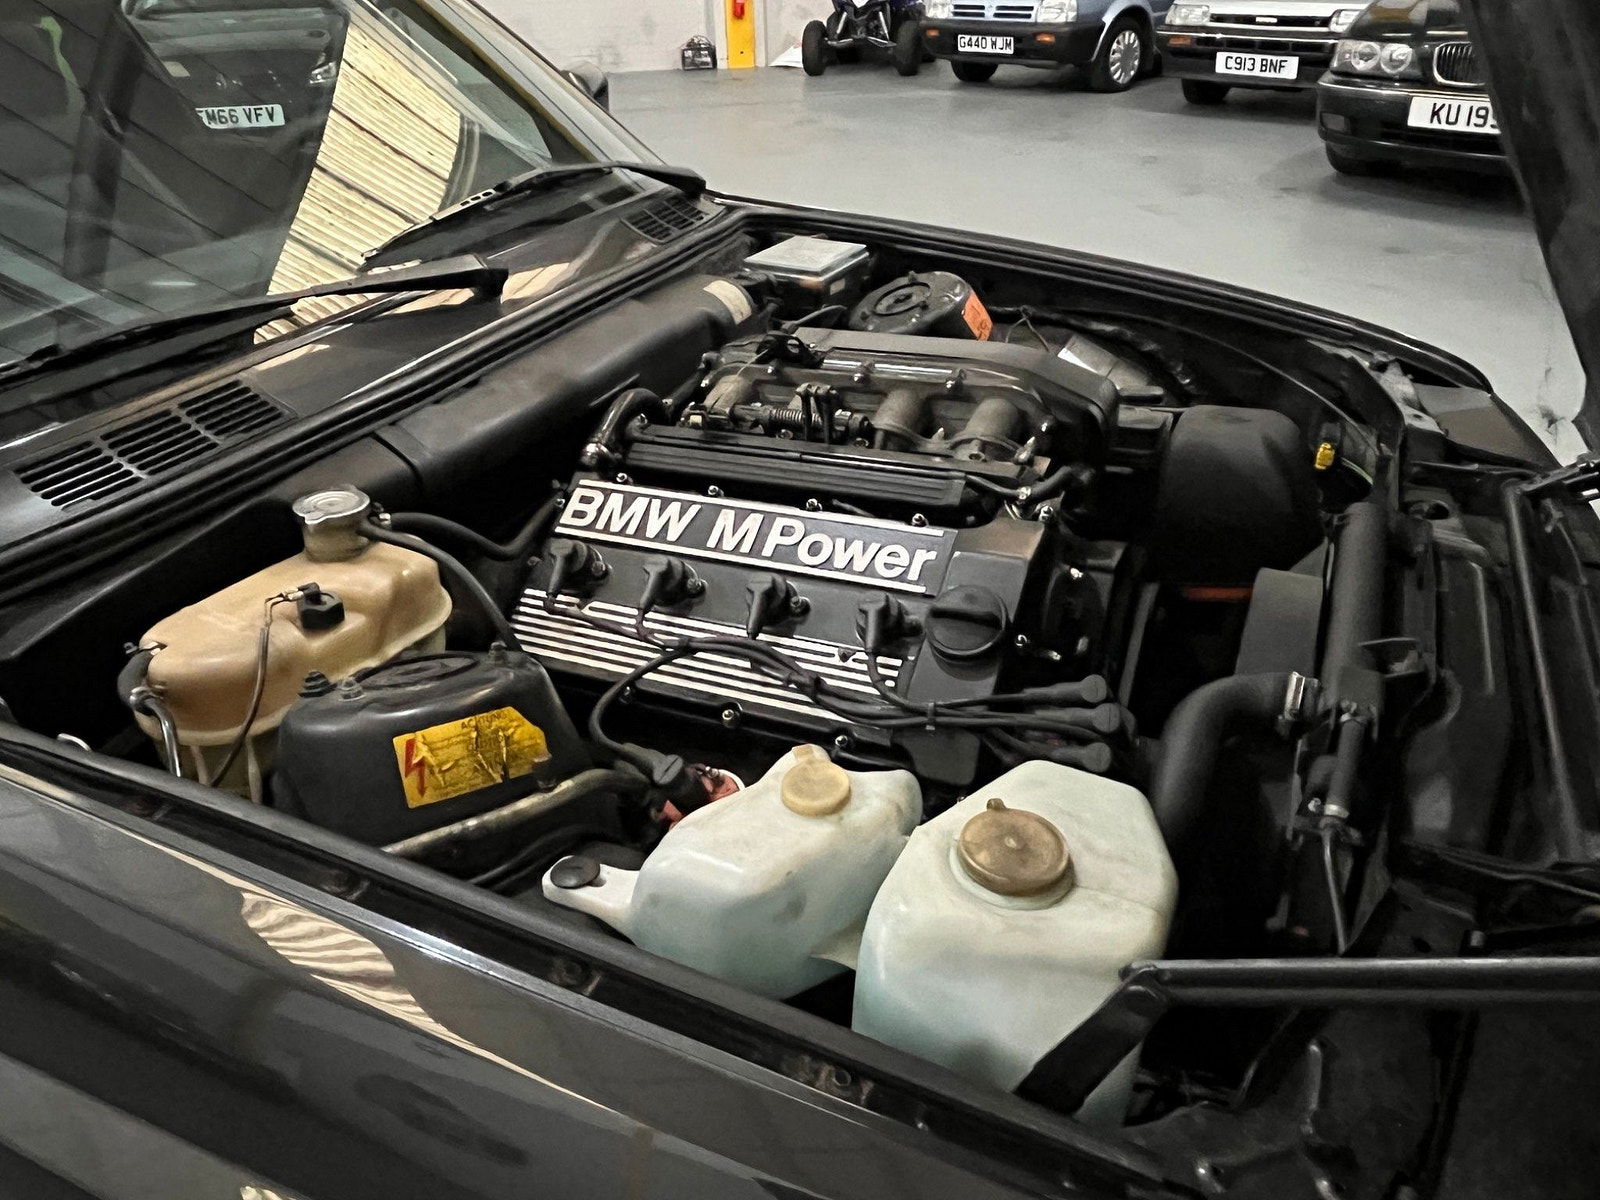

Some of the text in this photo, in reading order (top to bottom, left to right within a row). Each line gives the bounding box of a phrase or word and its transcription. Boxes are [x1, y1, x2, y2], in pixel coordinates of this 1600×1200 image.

[959, 36, 987, 50] G440
[1224, 55, 1288, 74] C913 BNF
[242, 105, 275, 124] VFV
[1429, 102, 1461, 126] KU
[558, 486, 702, 543] BMW
